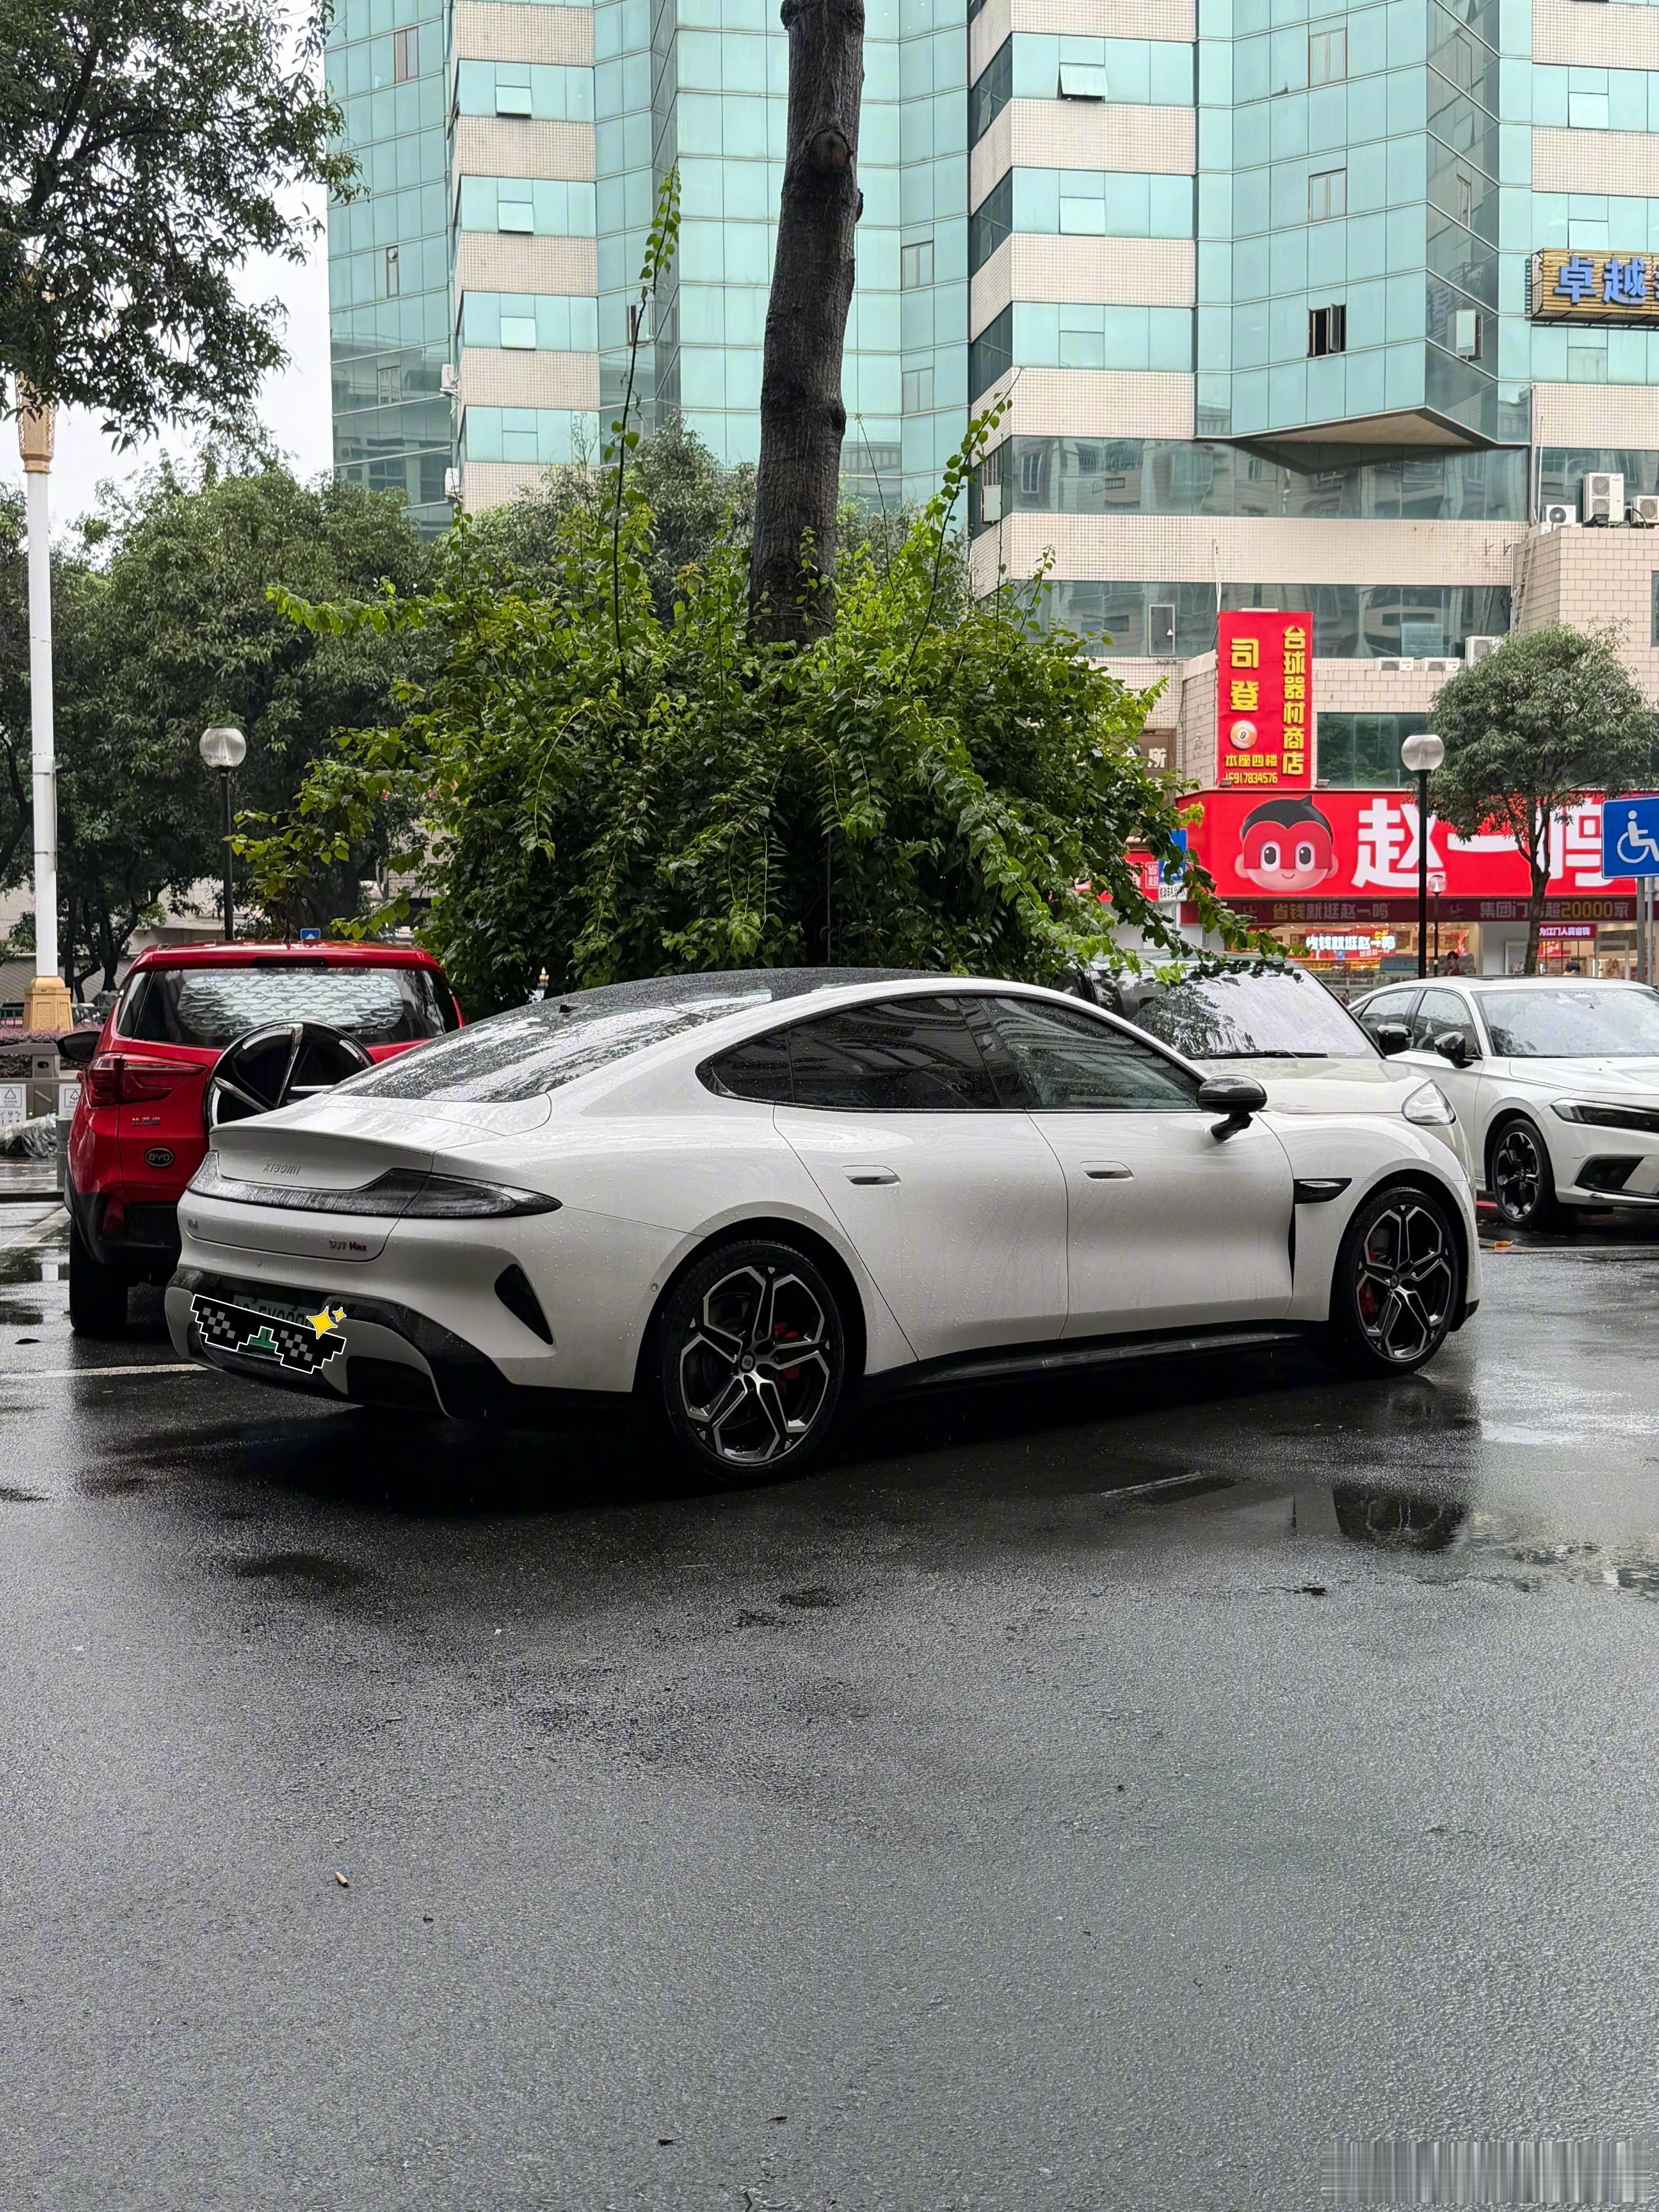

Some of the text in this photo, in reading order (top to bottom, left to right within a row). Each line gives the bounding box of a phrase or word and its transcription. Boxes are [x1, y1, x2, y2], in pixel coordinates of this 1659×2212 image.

[1553, 255, 1659, 306] 卓越
[1230, 638, 1259, 711] 司登
[1283, 625, 1306, 775] 台球器材商店
[1225, 754, 1278, 767] 本座四楼
[1273, 902, 1389, 920] 省钱就逛赵一鸣
[149, 1153, 170, 1162] BYD
